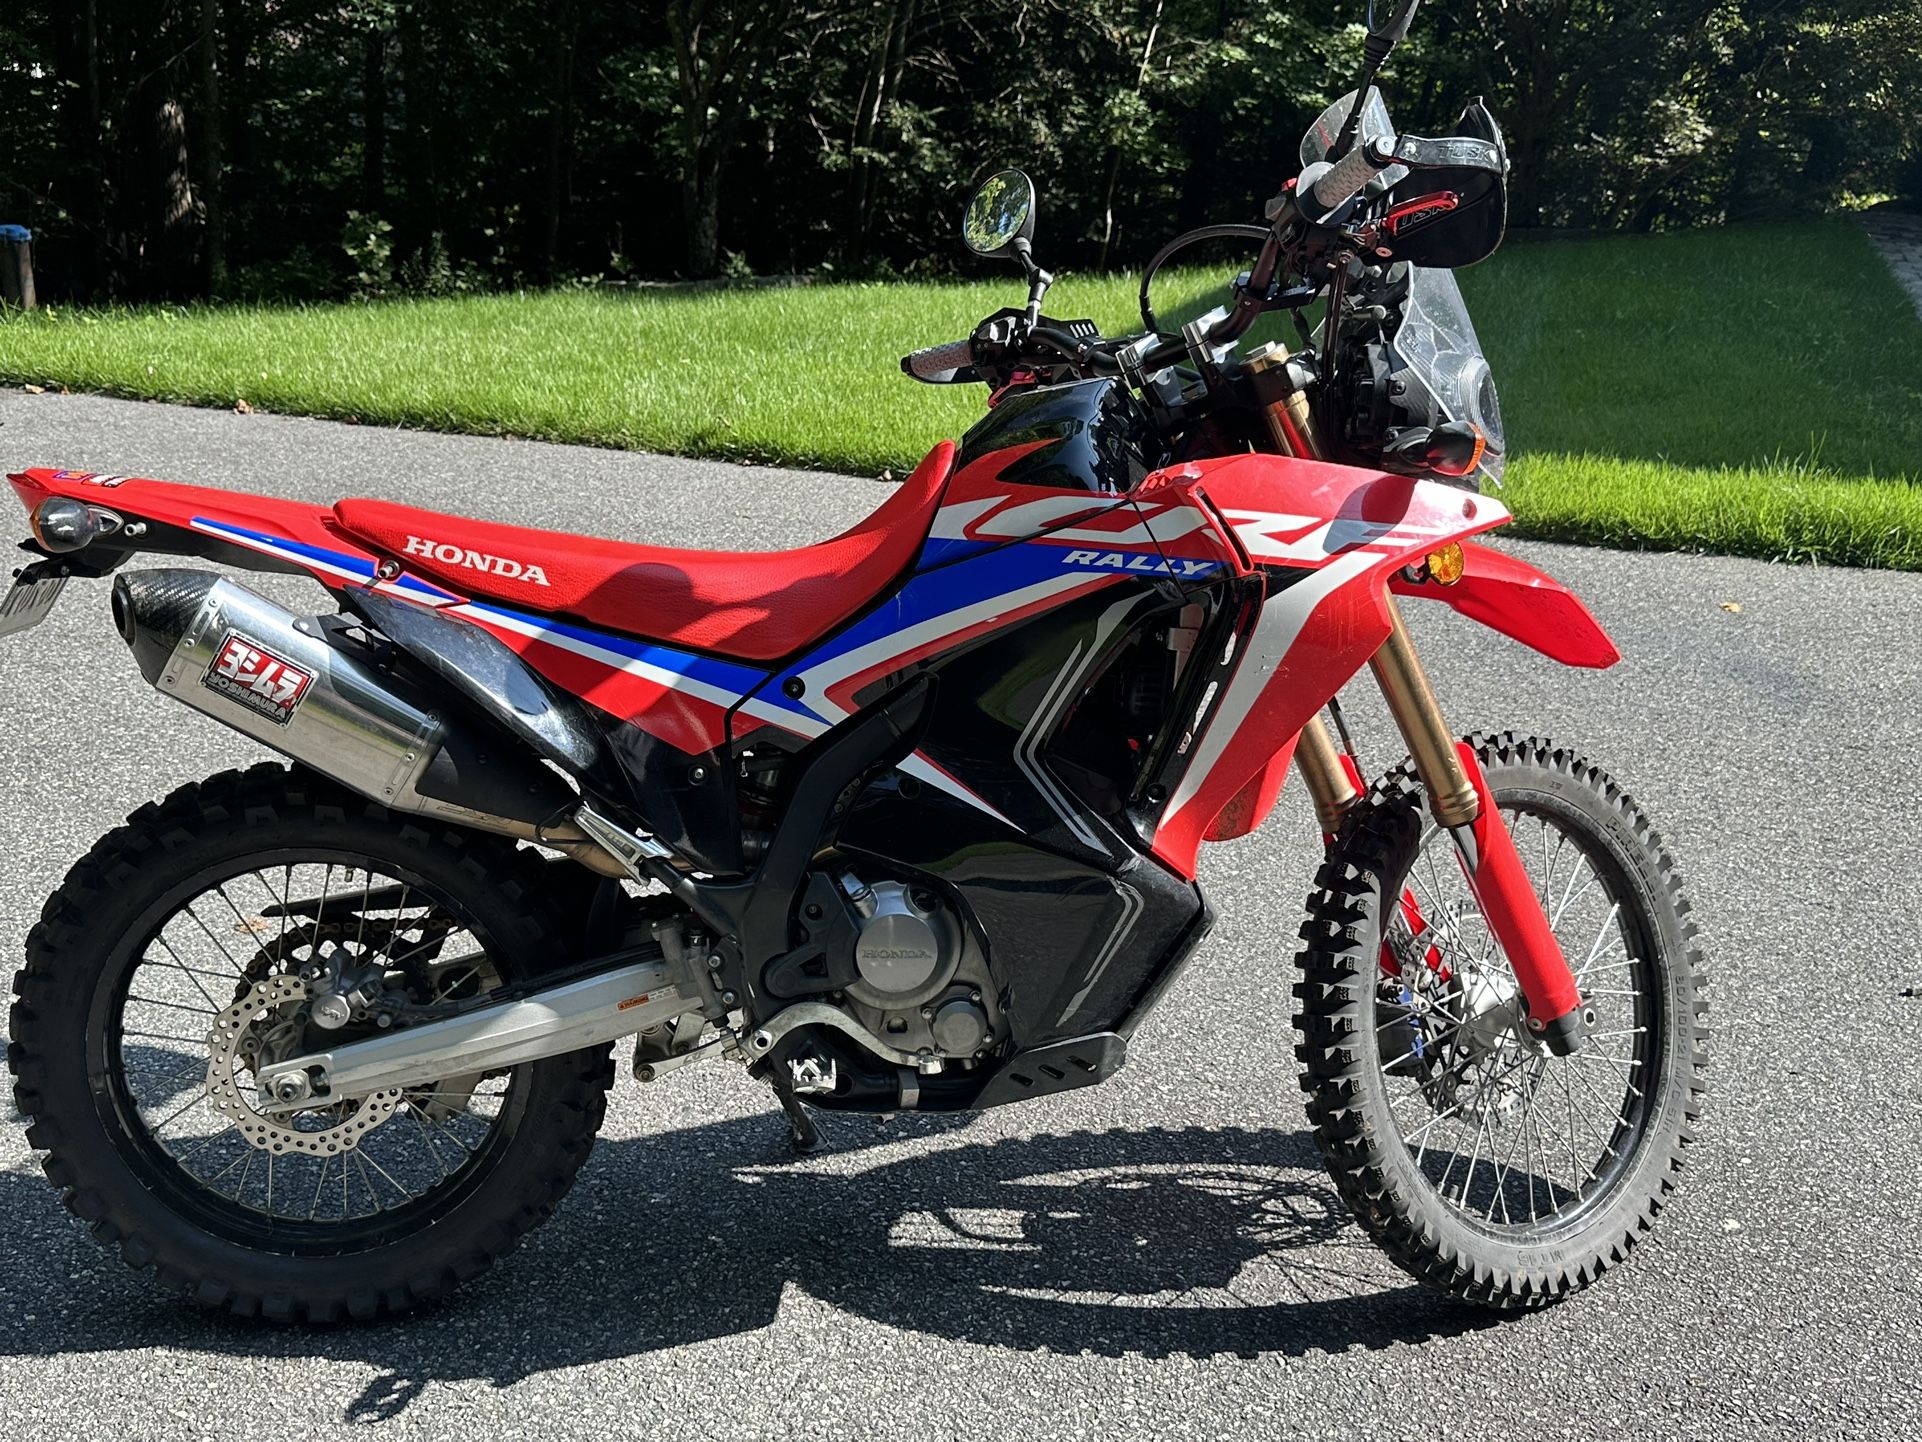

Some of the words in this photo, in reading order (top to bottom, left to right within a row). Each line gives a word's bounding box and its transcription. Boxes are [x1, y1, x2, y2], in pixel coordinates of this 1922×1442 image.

[1438, 145, 1490, 162] TUSK
[402, 535, 551, 586] HONDA
[1062, 550, 1214, 575] RALLY
[207, 672, 288, 719] YOSHIMURA
[217, 640, 303, 704] ヨシムラ
[1605, 816, 1664, 902] PIRELLI
[862, 948, 932, 959] HONDA
